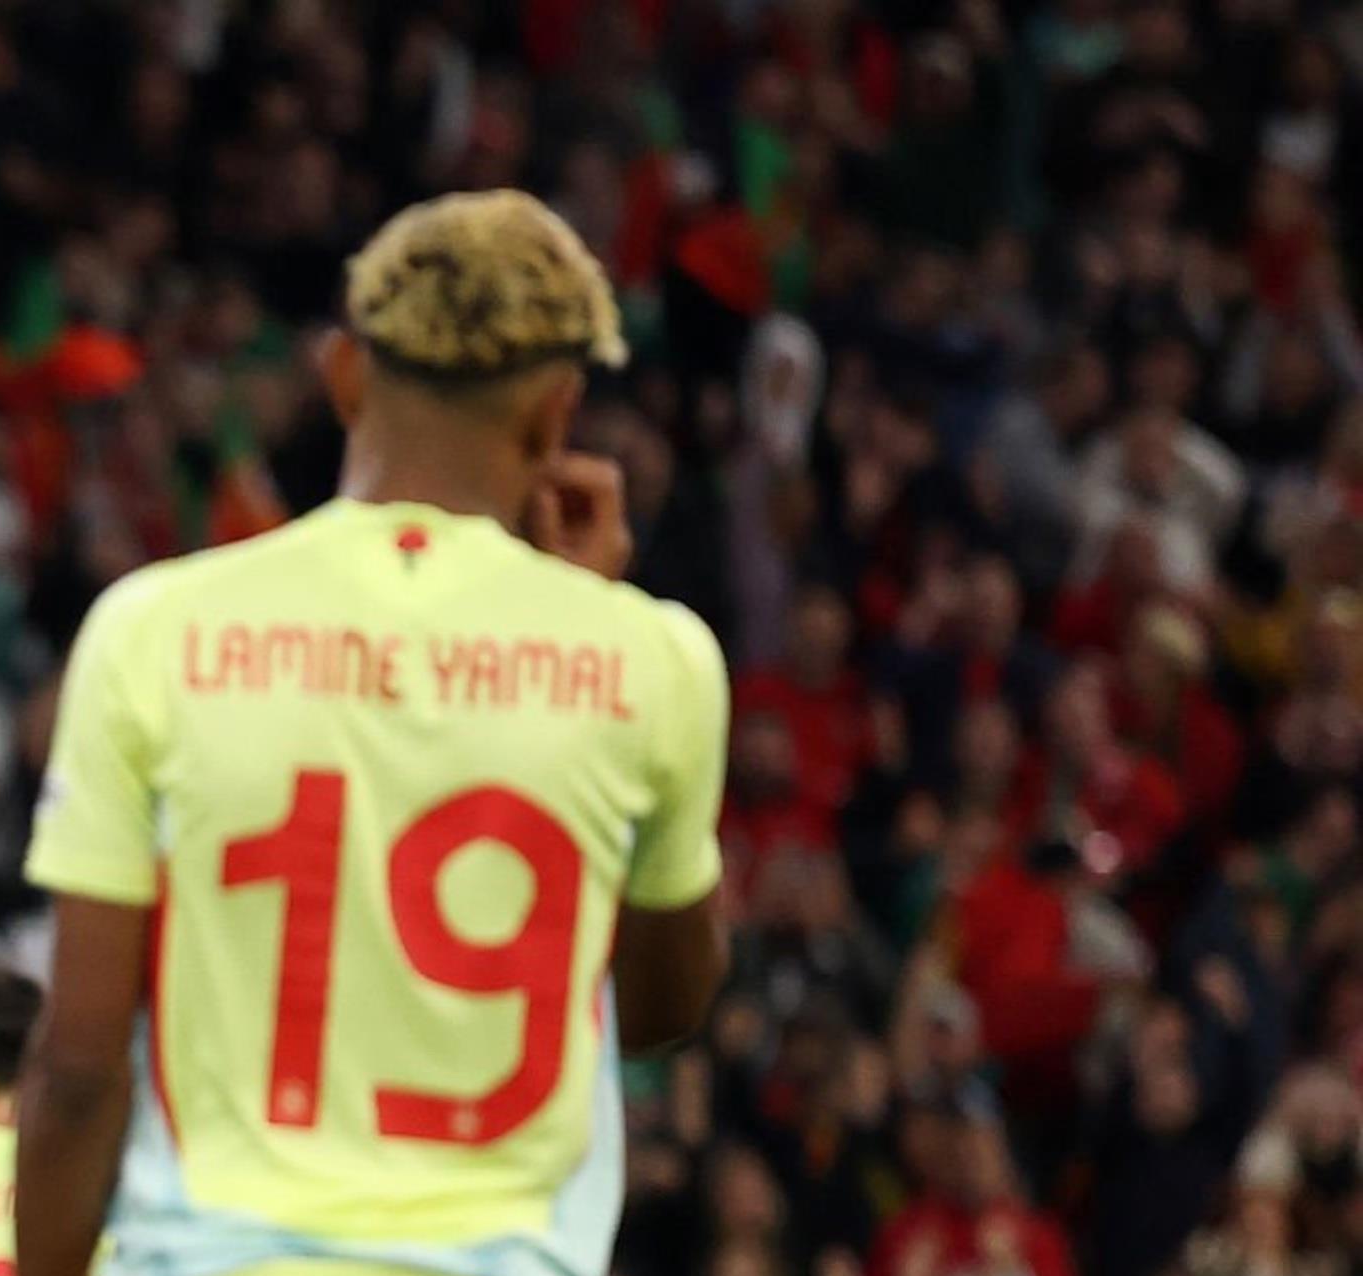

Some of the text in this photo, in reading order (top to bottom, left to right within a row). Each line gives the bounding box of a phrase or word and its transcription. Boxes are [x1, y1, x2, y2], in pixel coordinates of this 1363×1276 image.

[183, 623, 635, 721] LAMINE YAMAL
[219, 767, 585, 1147] 19
